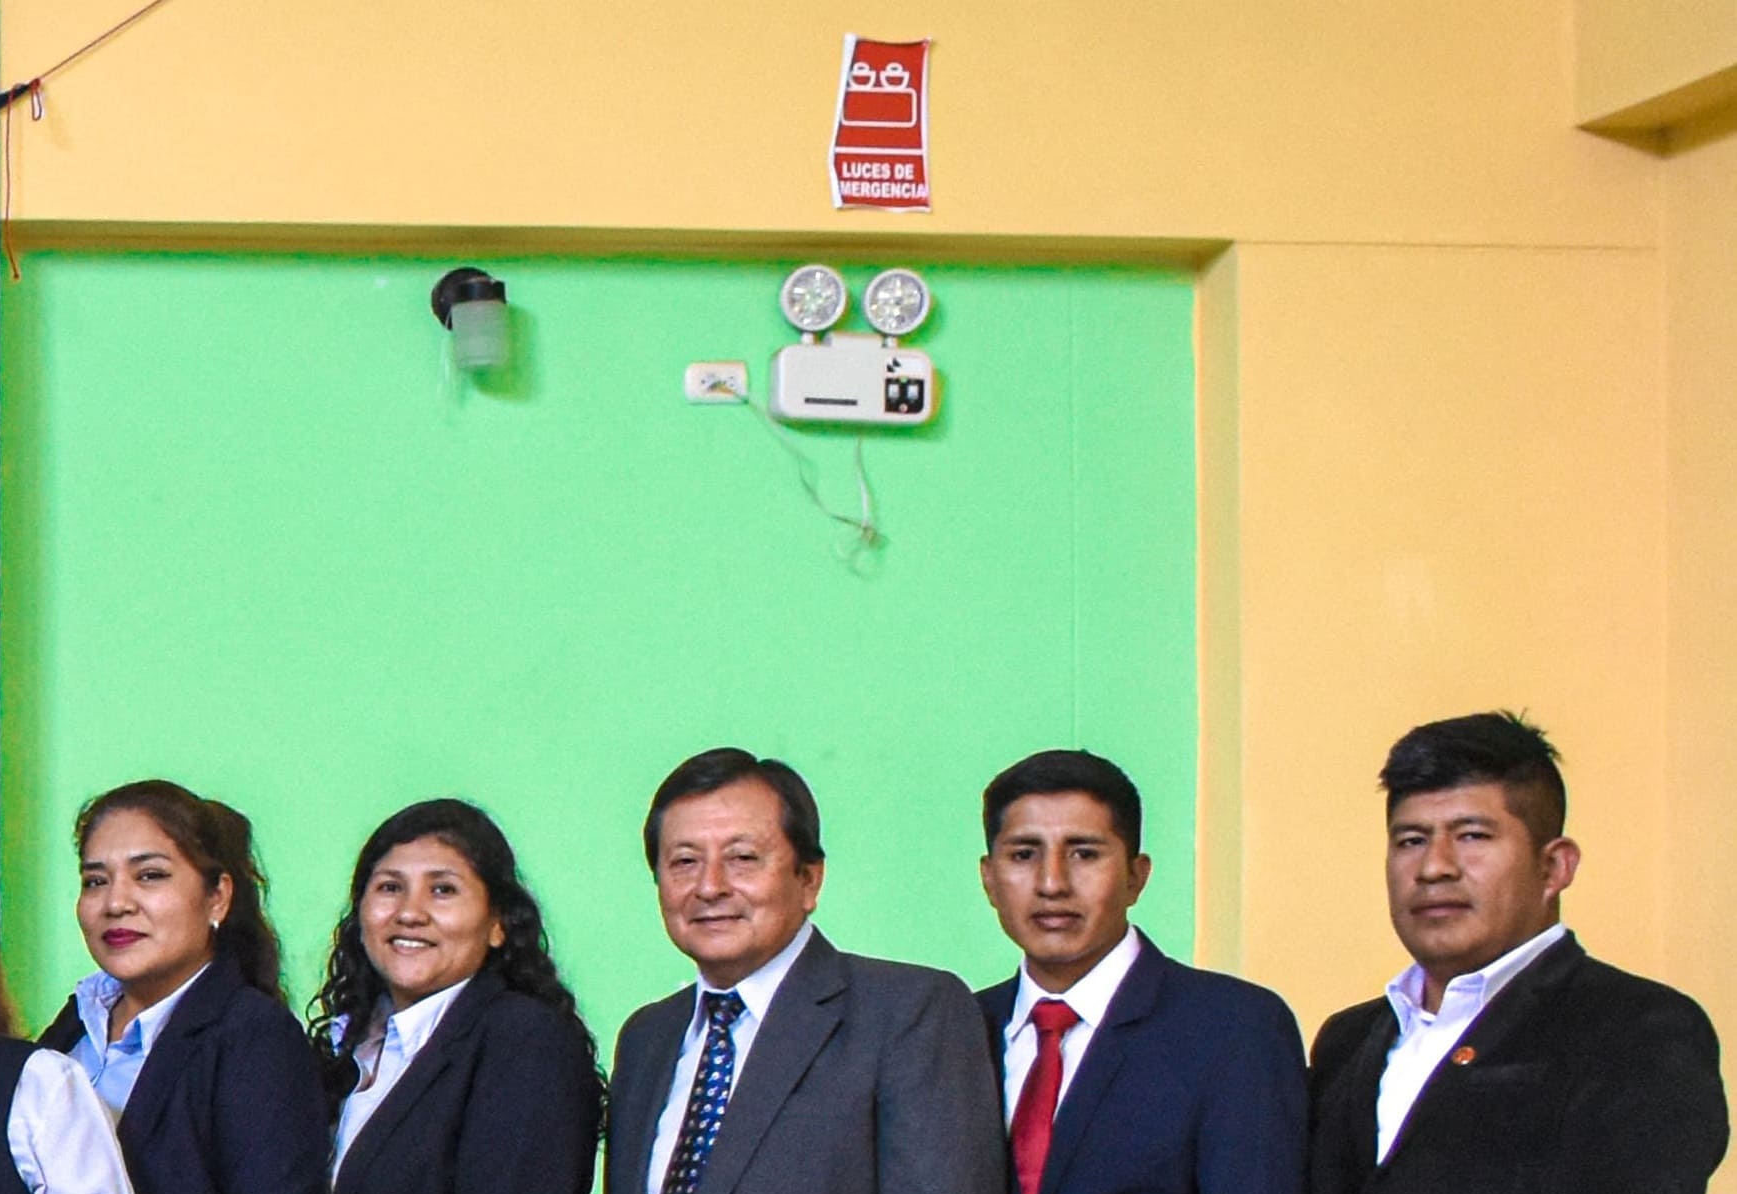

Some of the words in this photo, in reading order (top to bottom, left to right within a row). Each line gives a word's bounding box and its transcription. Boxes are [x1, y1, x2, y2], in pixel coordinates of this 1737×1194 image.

[842, 161, 891, 179] LUCES
[895, 163, 915, 180] DE
[840, 181, 928, 199] MERGENCIA
